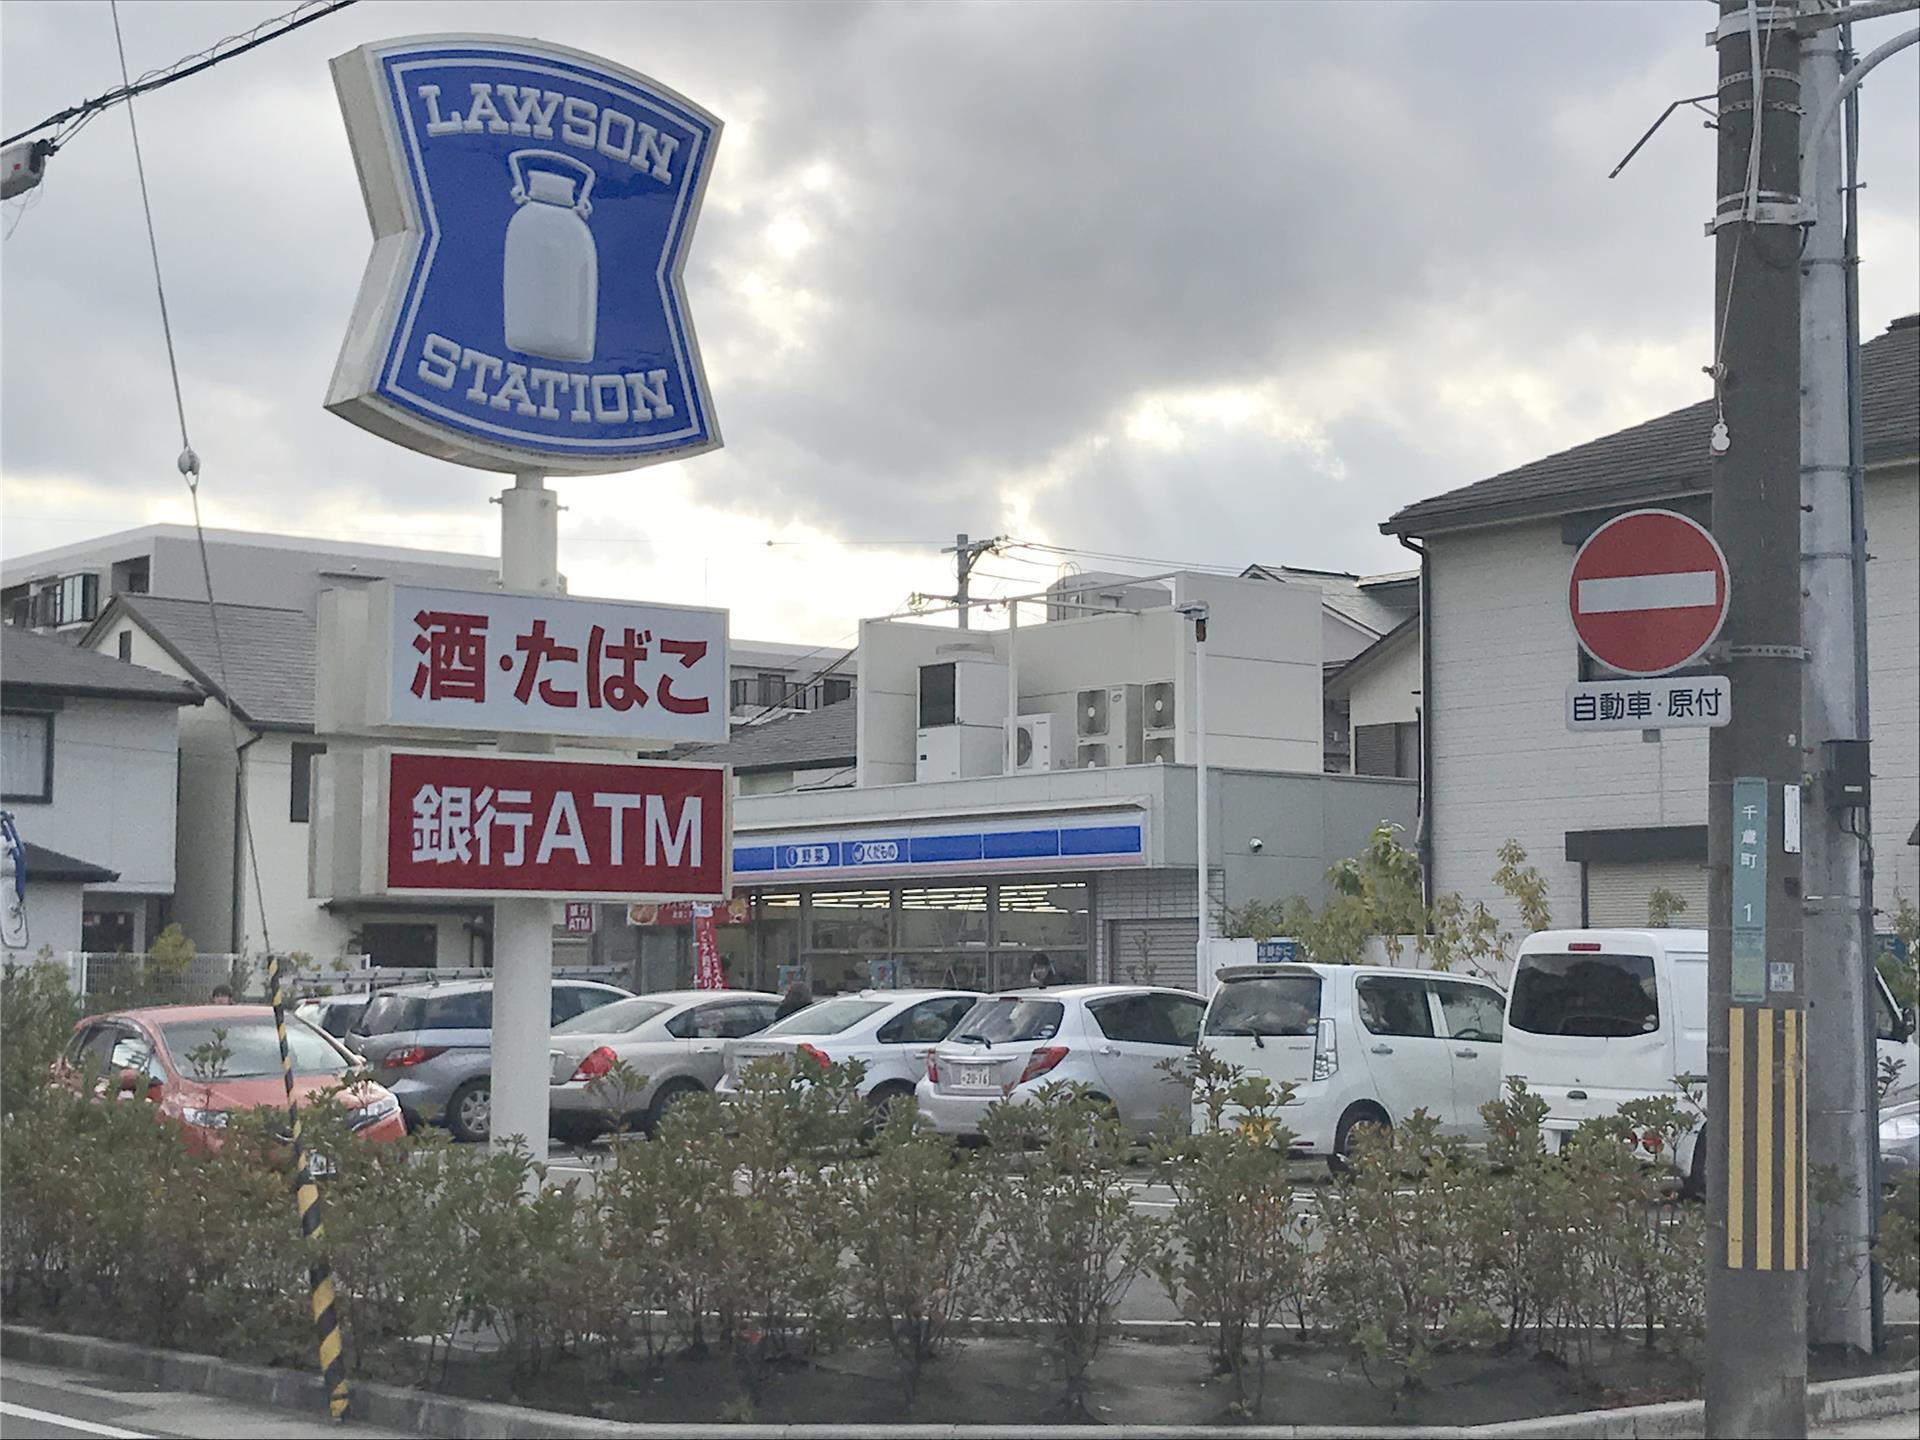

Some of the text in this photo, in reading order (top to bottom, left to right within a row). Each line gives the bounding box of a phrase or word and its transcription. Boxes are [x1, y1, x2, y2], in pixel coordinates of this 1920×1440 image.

[418, 82, 680, 187] LAWSON
[417, 333, 675, 423] STATION
[410, 609, 710, 714] 酒・たばこ
[1573, 687, 1722, 722] 自動車・原付
[411, 784, 702, 868] 銀行ATM
[866, 844, 896, 860] くだもの
[1741, 804, 1758, 923] 千歳町 1
[568, 917, 590, 931] ATM
